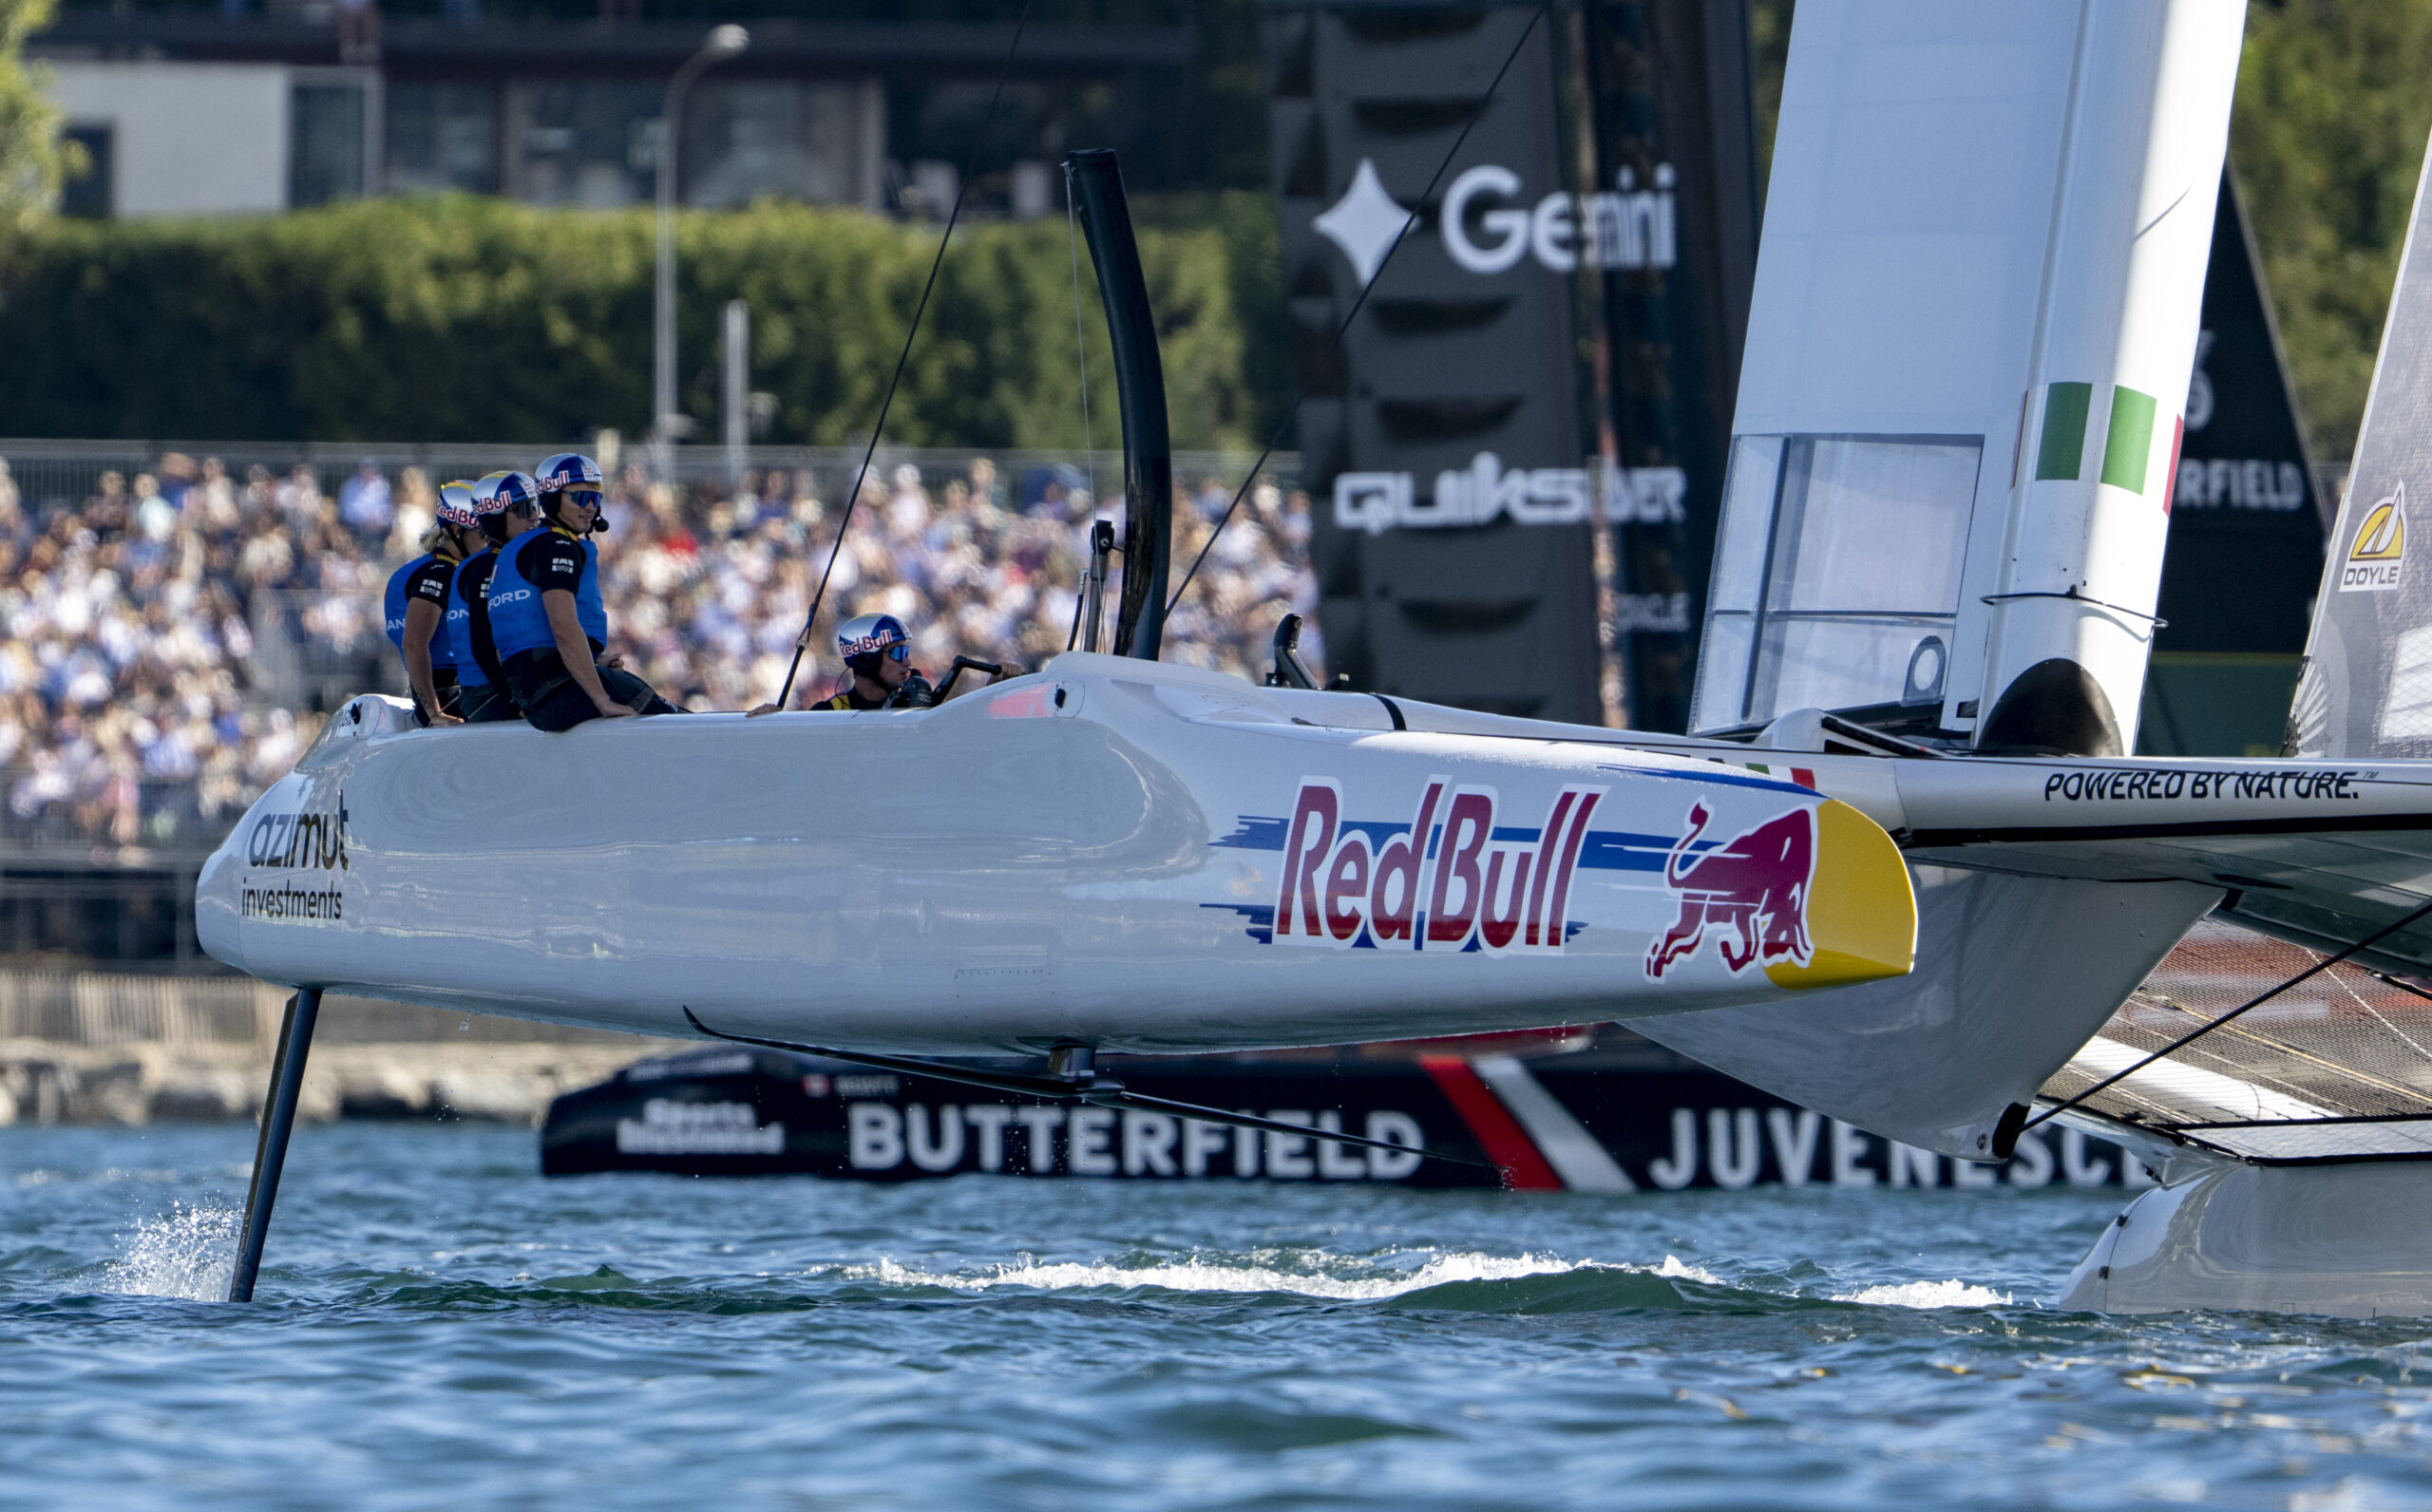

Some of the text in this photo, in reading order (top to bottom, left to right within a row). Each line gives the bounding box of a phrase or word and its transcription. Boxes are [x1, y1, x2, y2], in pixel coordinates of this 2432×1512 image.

[544, 470, 569, 491] Bull
[2178, 459, 2304, 510] RFIELD
[484, 490, 512, 512] Bull
[457, 509, 478, 527] Bu
[2344, 566, 2400, 586] DOYLE
[840, 629, 892, 657] Red Bull
[2044, 770, 2186, 802] POWERED
[2191, 770, 2234, 799] BY
[2234, 771, 2360, 800] NATURE.
[249, 789, 350, 871] azimut
[1275, 782, 1603, 949] Red Bull
[241, 878, 343, 920] investments
[849, 1103, 1424, 1179] BUTTERFIELD
